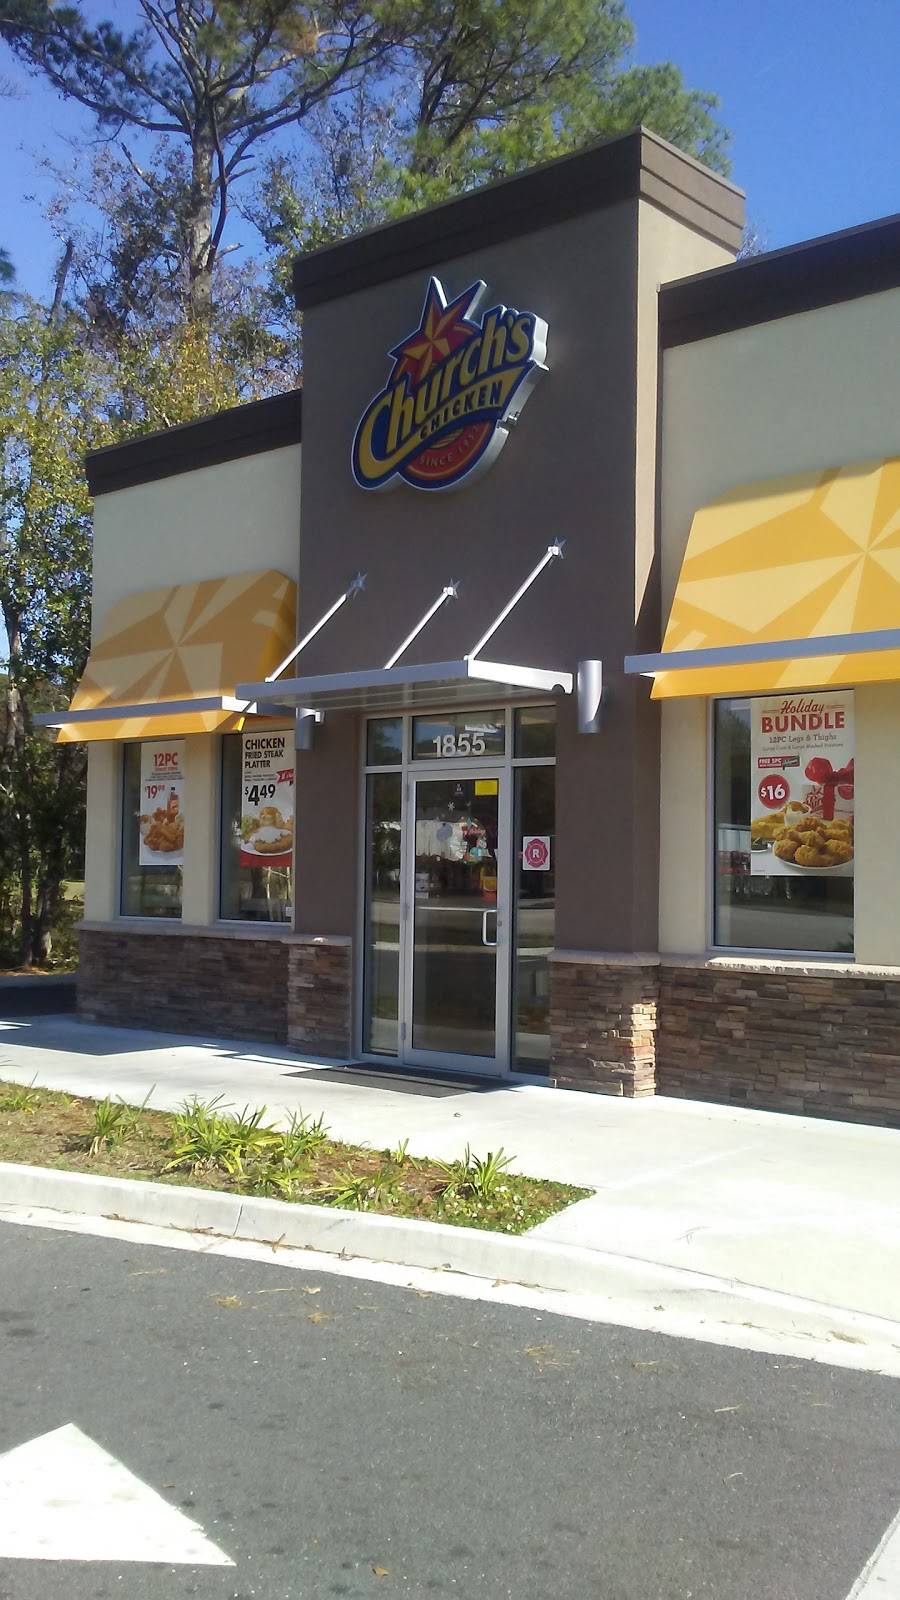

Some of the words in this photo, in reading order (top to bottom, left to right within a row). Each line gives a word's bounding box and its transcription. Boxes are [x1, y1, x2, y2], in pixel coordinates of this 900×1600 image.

[359, 312, 530, 479] Church's
[420, 380, 503, 440] CHICKEN
[420, 452, 453, 467] SINCE
[781, 699, 825, 714] Holiday
[761, 711, 845, 734] BUNDLE
[245, 737, 285, 750] CHICKEN
[432, 732, 486, 758] 1855
[769, 735, 787, 743] 12PC
[789, 733, 804, 743] Legs
[153, 752, 179, 767] 12PC
[244, 751, 262, 759] FRIED
[263, 750, 284, 758] STEAK
[244, 760, 271, 768] PLATTER
[760, 783, 786, 800] $16
[532, 849, 540, 858] R
